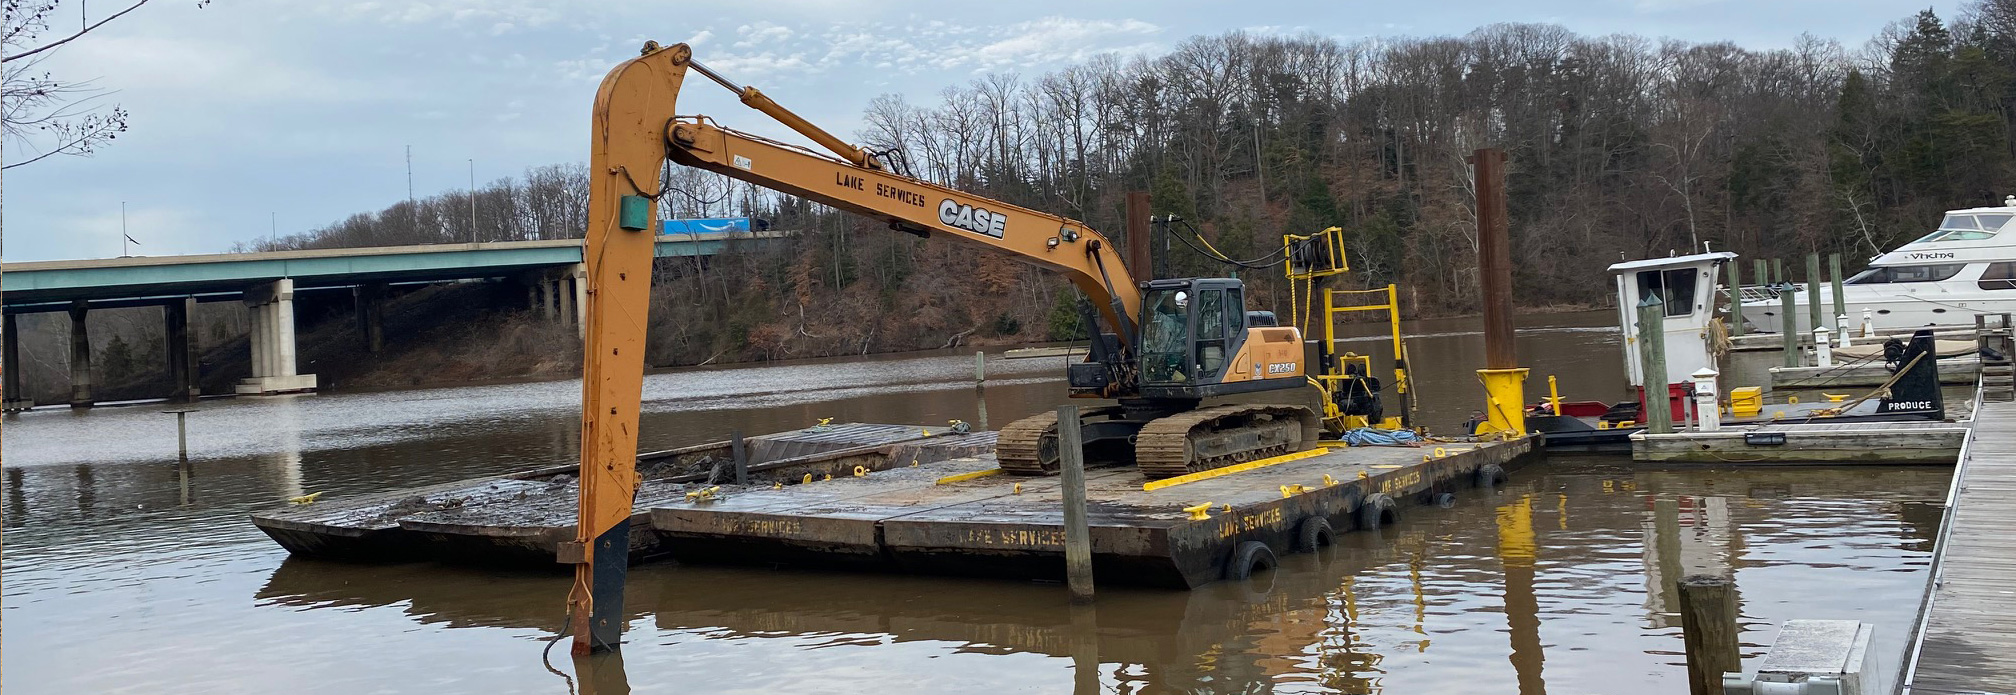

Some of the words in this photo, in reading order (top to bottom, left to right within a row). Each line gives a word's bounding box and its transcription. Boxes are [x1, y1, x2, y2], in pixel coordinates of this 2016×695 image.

[836, 171, 865, 191] LAKE
[876, 183, 925, 208] SERVICES
[938, 198, 1007, 240] CASE
[1268, 362, 1296, 374] CX250
[1888, 401, 1932, 411] PRODUCE
[1244, 507, 1281, 531] SERVICES
